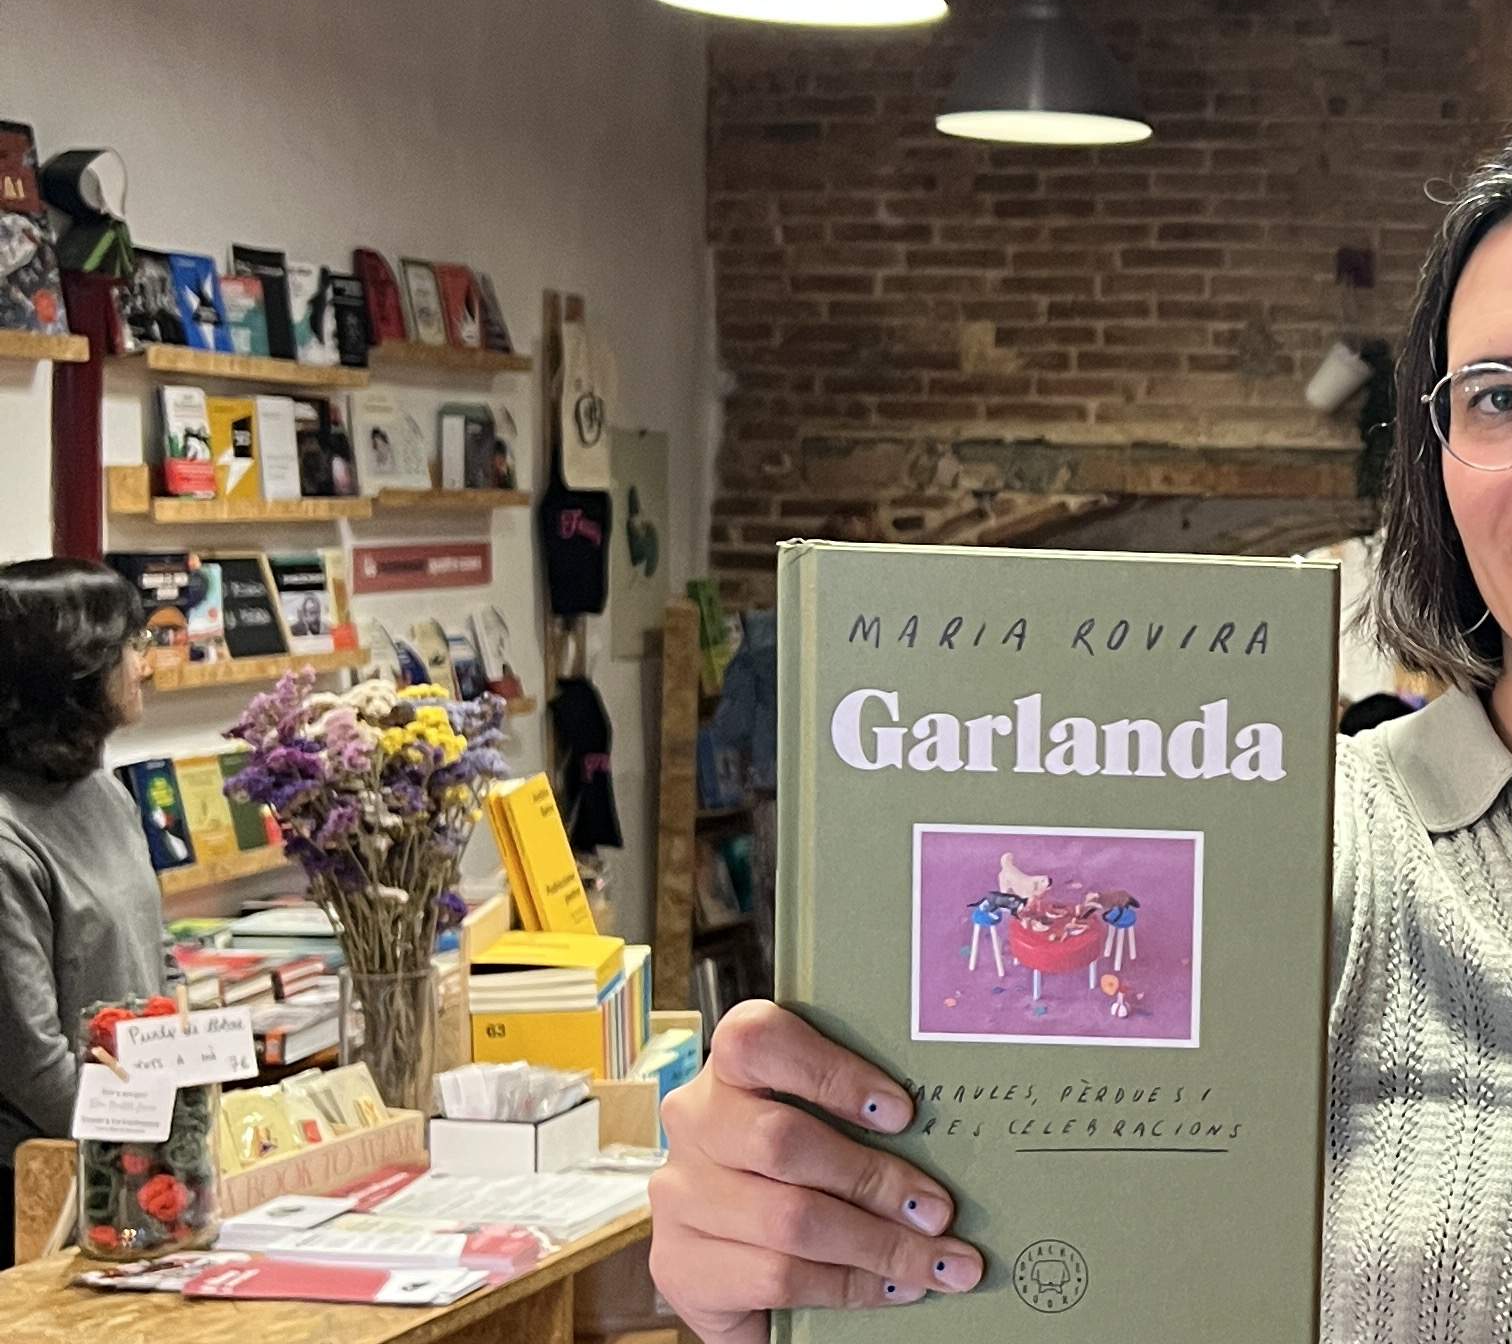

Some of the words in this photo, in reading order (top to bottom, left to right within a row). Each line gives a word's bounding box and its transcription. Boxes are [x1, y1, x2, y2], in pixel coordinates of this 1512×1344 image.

[849, 614, 1028, 650] MARIA
[1071, 617, 1270, 656] ROVIRA
[831, 689, 1287, 781] Garlanda
[1008, 1119, 1243, 1139] CELEBRACIONS
